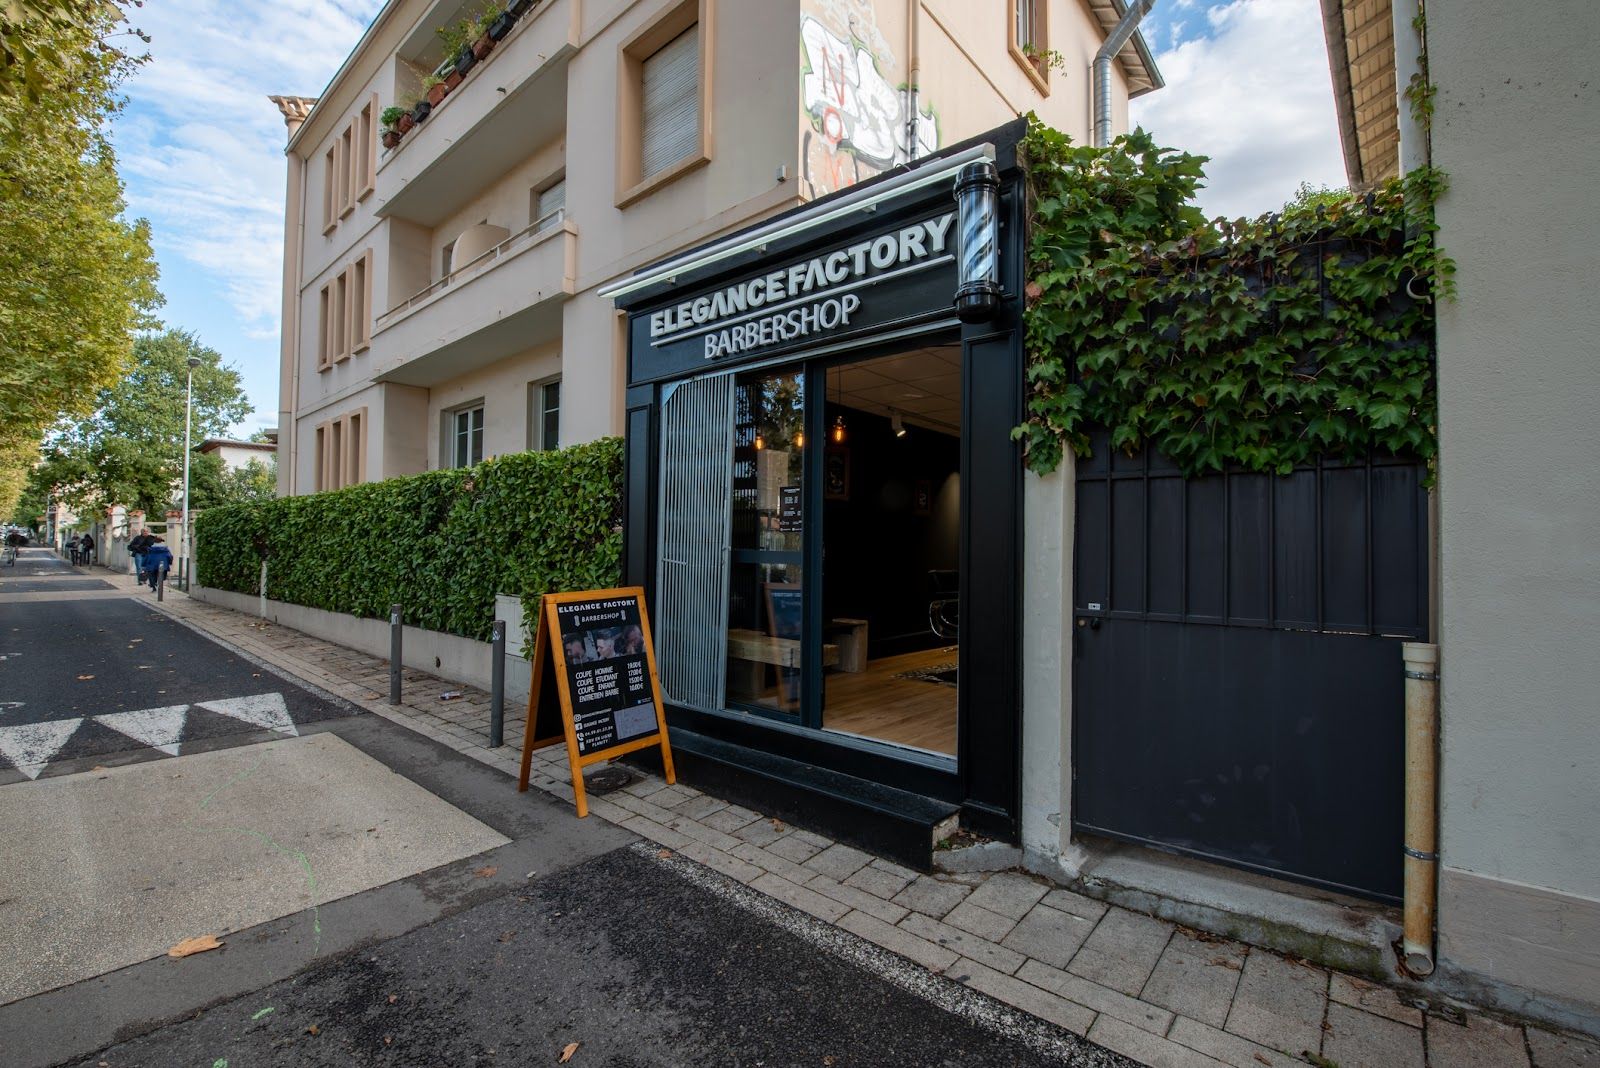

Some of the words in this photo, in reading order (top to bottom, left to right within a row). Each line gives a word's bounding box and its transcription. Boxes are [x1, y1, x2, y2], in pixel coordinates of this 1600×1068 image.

[704, 293, 860, 360] BARBERSHOP
[558, 603, 601, 613] ELEGANCE
[603, 600, 636, 608] FACTORY
[581, 613, 619, 622] BARBERSHOP
[575, 670, 593, 680] COUPE
[595, 666, 613, 675] HOMME
[576, 677, 594, 688] COUPE
[596, 673, 618, 683] ETUDIANT
[578, 685, 595, 695] COUPE
[598, 681, 615, 690] ENFANT
[579, 691, 604, 703] ENTRETIEN
[604, 687, 619, 697] BARBE
